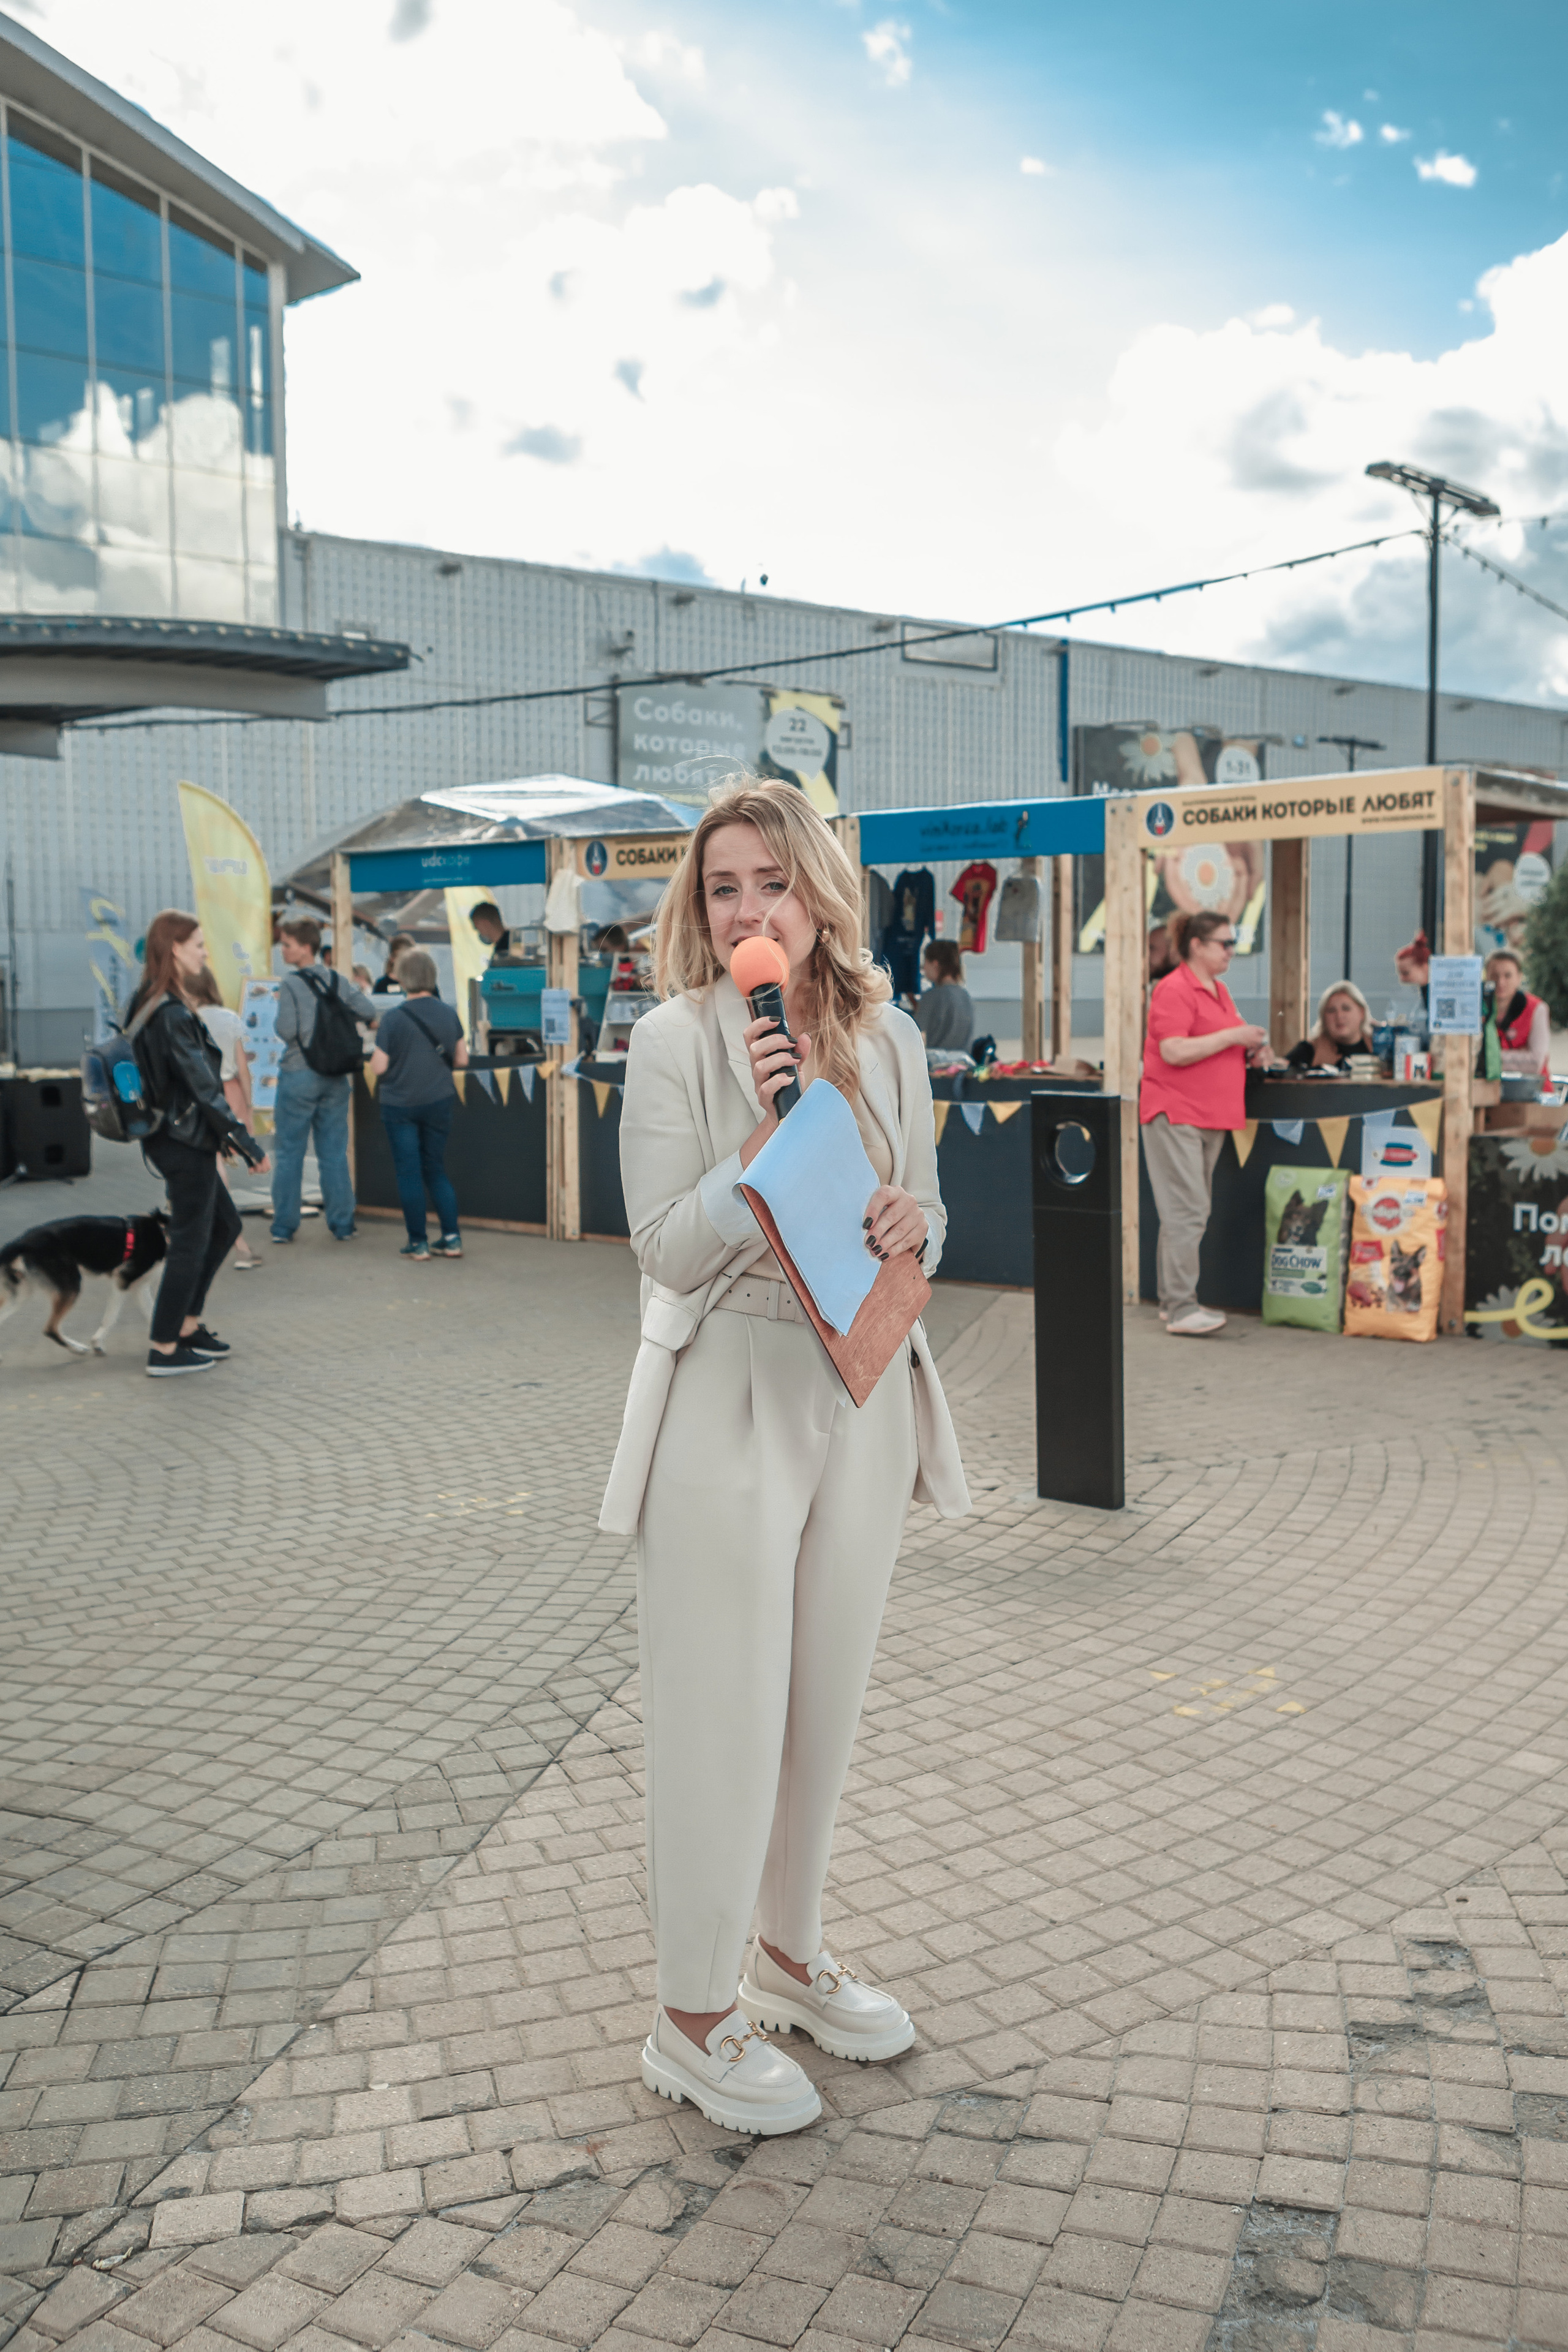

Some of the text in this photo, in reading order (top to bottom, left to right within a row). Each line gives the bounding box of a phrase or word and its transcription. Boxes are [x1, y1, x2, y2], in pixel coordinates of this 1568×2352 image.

[1182, 803, 1257, 826] СОБАКИ
[1262, 796, 1355, 820] КОТОРЫЕ
[1362, 791, 1436, 813] ЛЮБЯТ
[616, 846, 677, 865] СОБАКИ
[1289, 1254, 1322, 1268] CHOW
